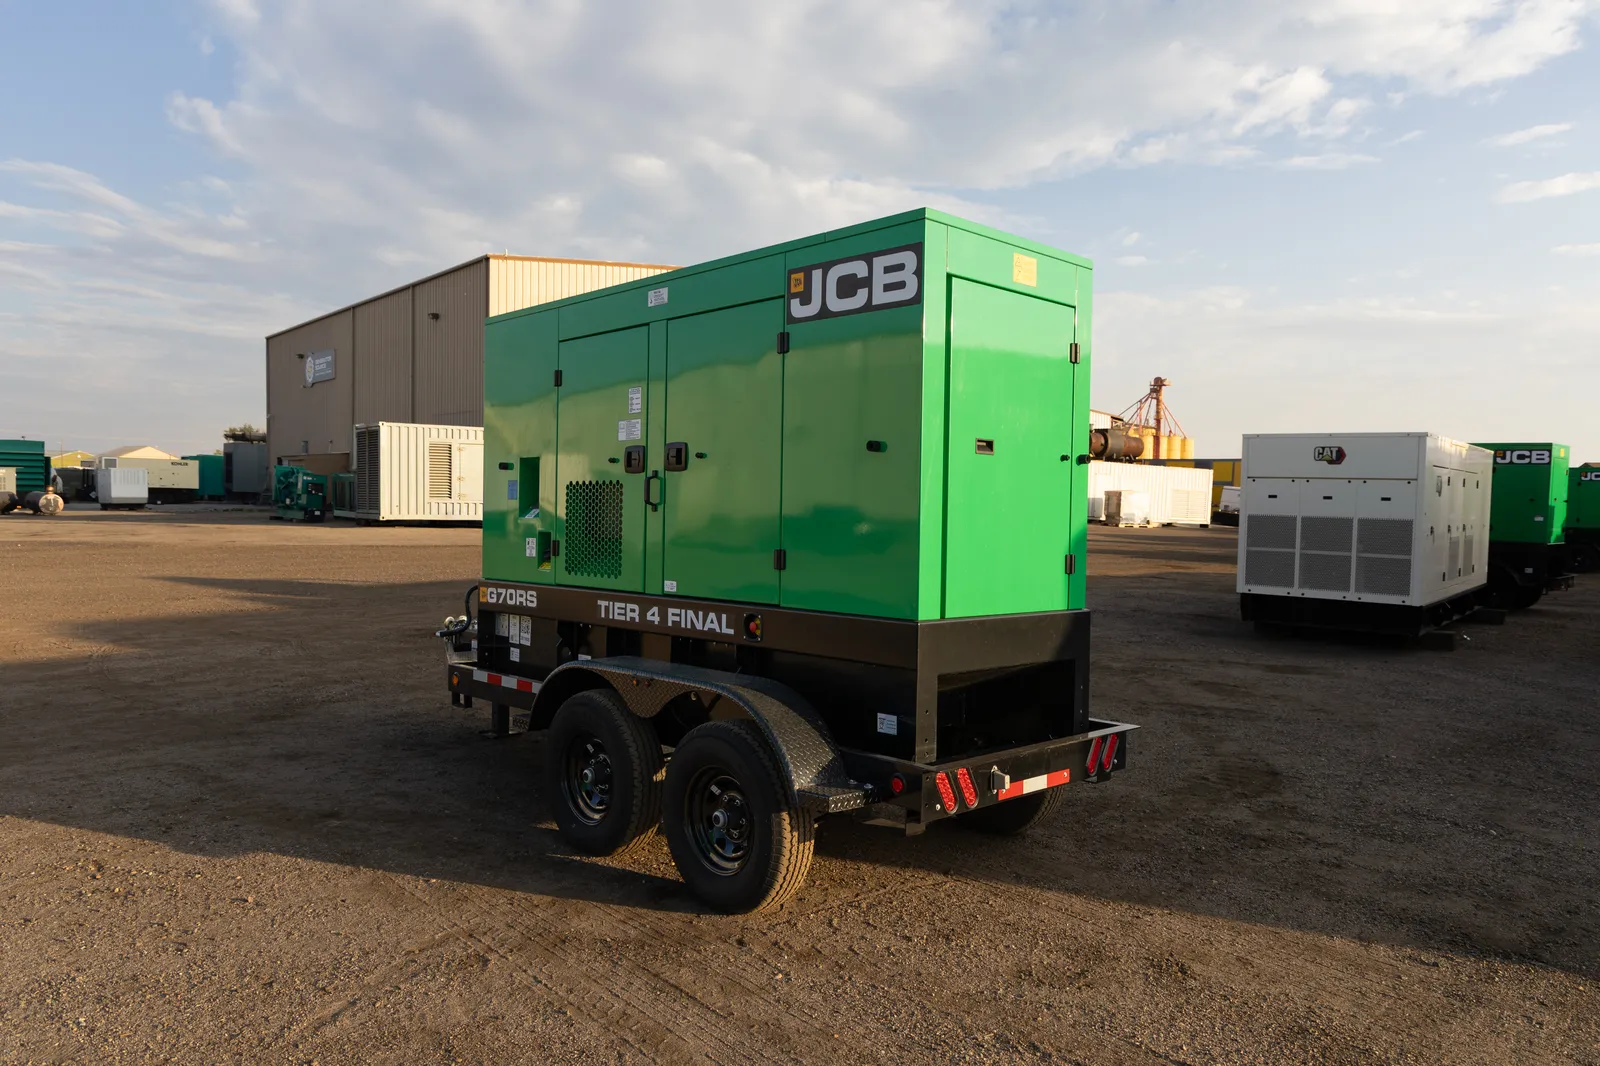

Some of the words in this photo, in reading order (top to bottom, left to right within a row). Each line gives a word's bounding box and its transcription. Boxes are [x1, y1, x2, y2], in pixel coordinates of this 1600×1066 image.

[790, 250, 919, 319] JCB
[1314, 446, 1339, 461] CAT
[1495, 450, 1551, 464] JCB
[487, 587, 537, 607] G70RS
[597, 600, 640, 623] TIER
[646, 606, 660, 625] 4
[667, 607, 735, 635] FINAL
